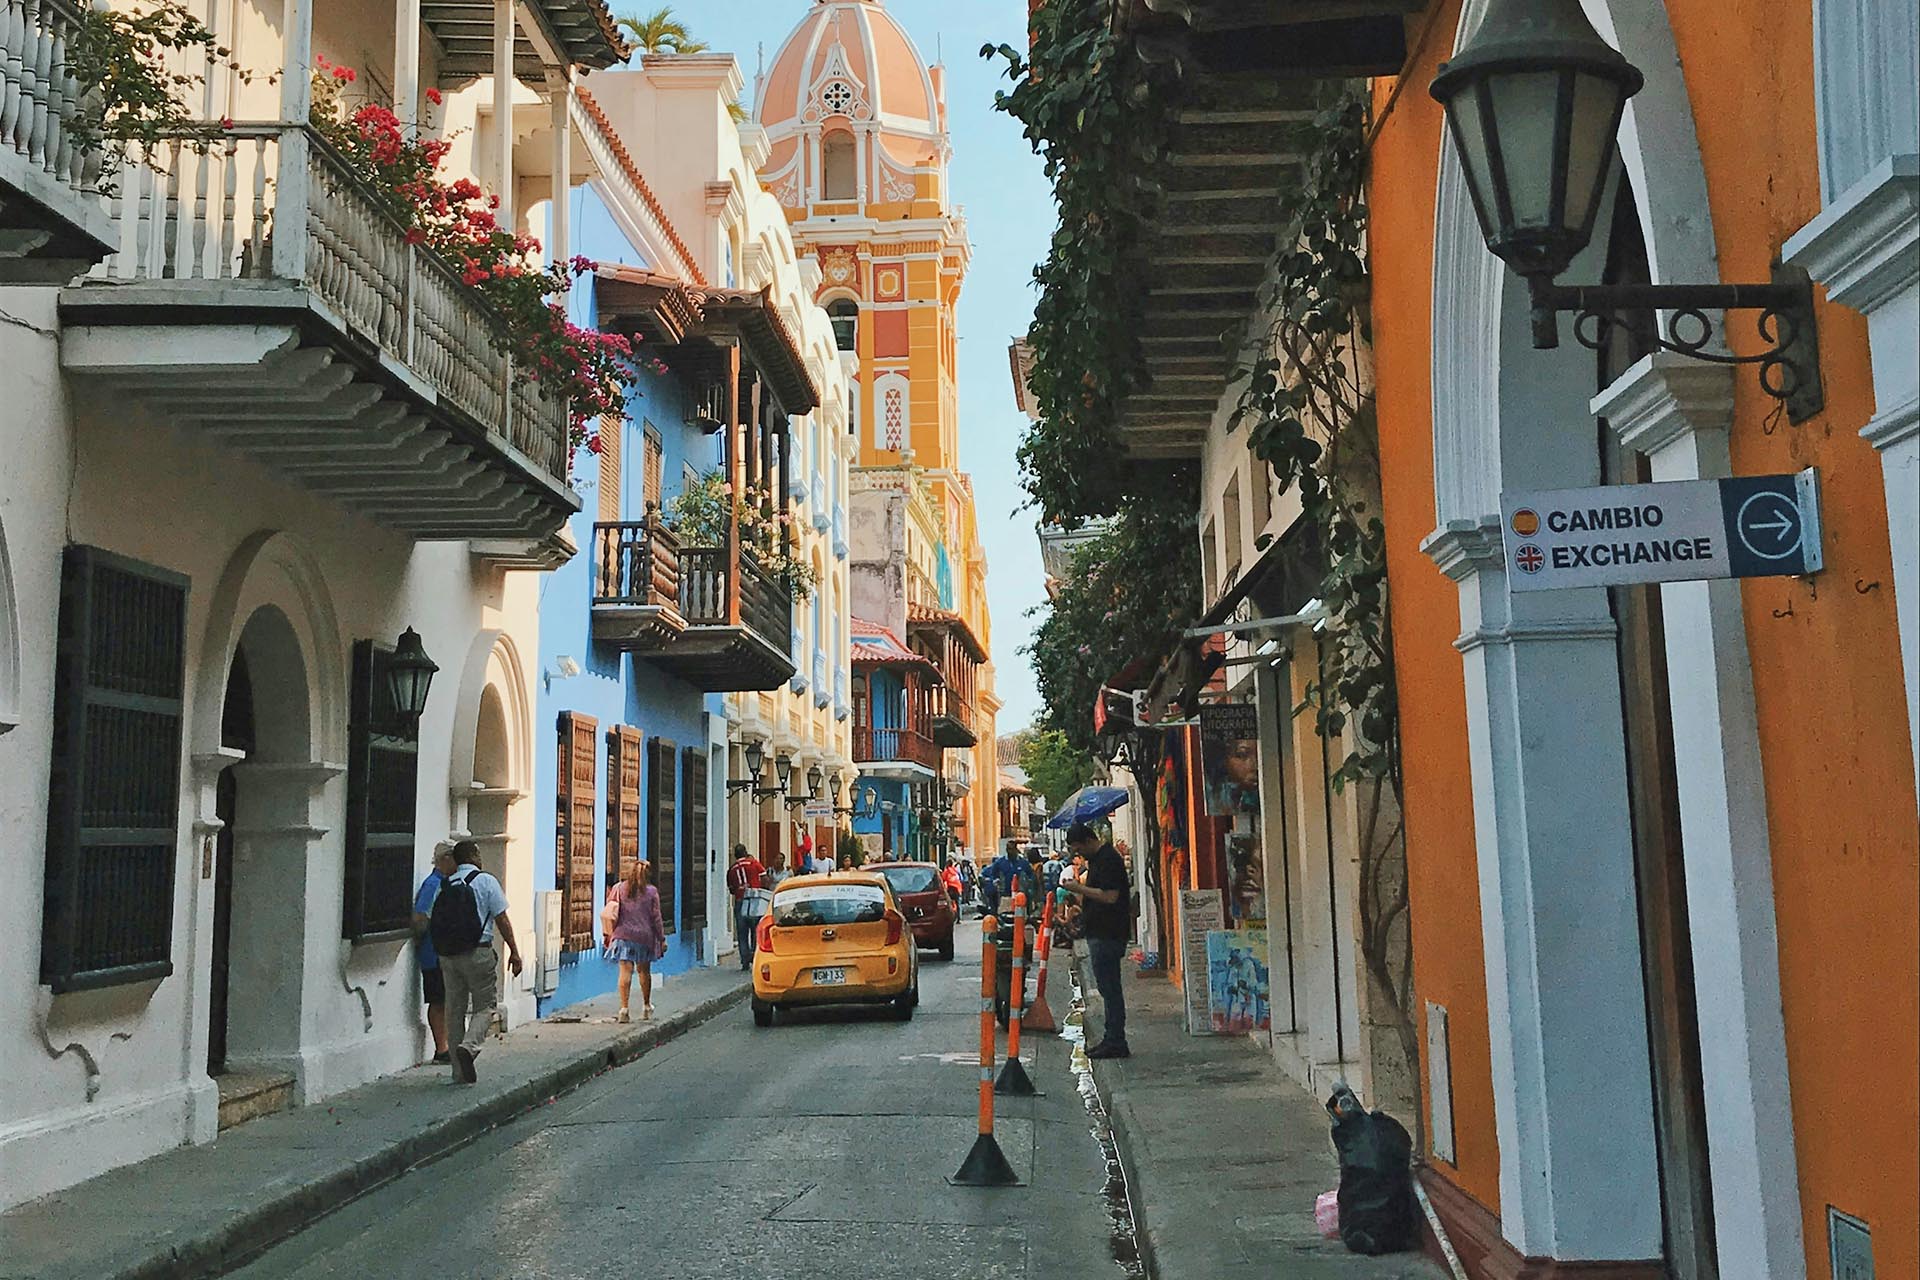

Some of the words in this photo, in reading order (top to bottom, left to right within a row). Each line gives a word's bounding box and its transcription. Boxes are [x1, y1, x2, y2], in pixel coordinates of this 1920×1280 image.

[1547, 504, 1664, 533] CAMBIO
[1552, 537, 1713, 569] EXCHANGE
[736, 867, 747, 885] 11
